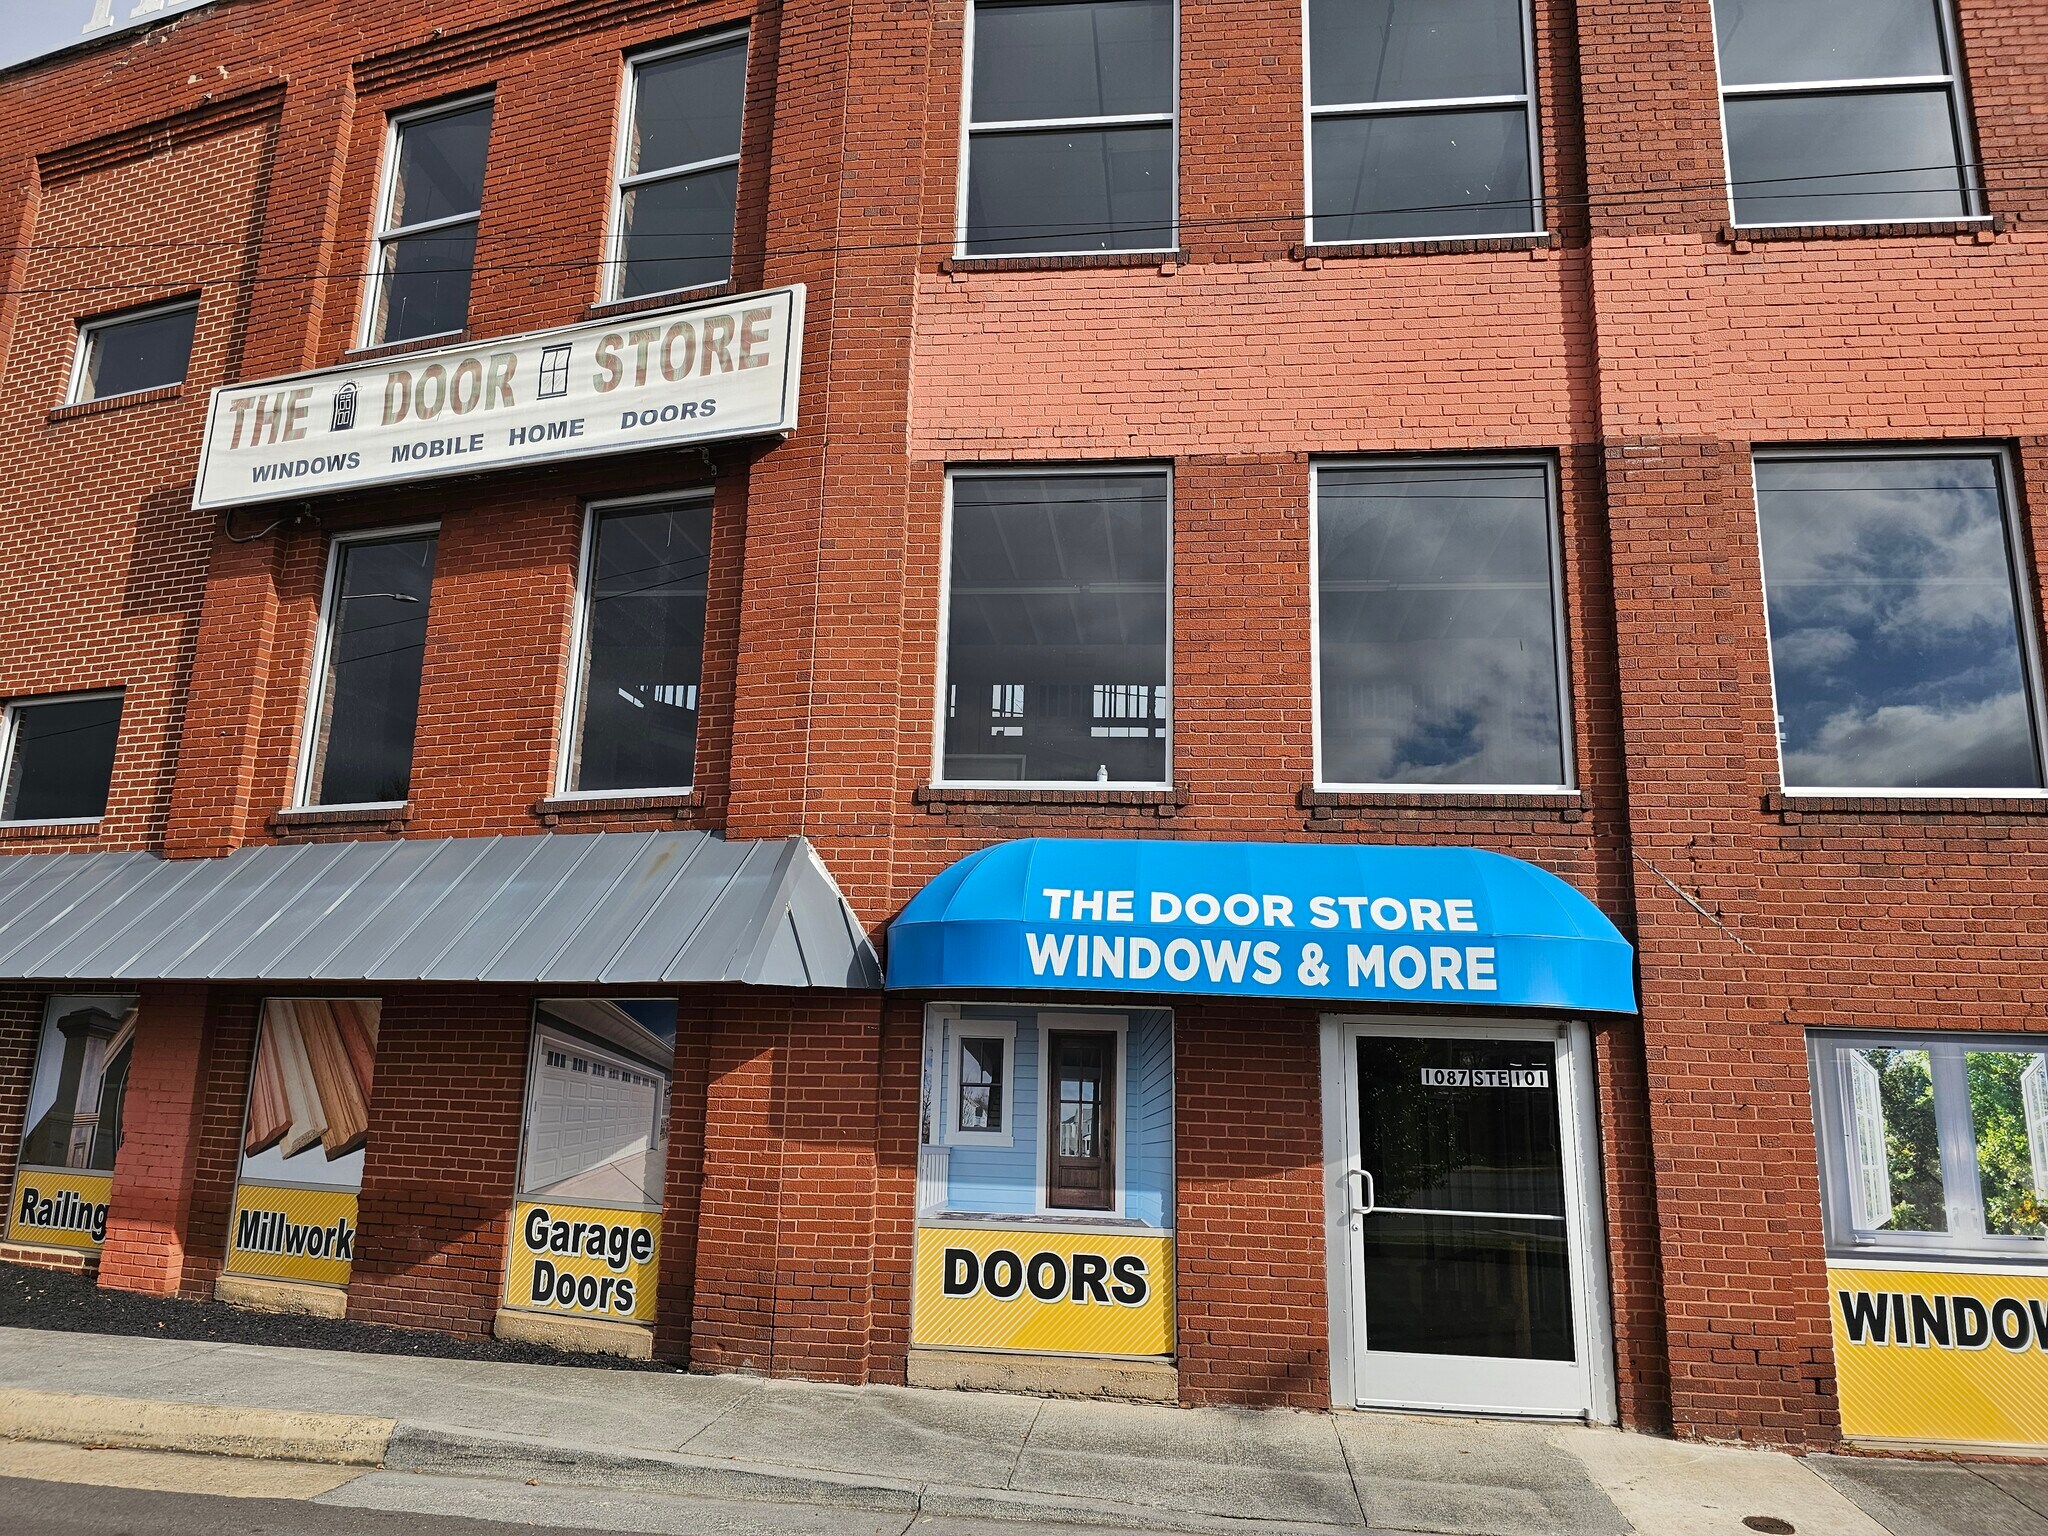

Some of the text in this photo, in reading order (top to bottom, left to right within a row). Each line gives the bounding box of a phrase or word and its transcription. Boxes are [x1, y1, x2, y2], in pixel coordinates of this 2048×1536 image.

[229, 306, 773, 450] THE DOOR STORE
[251, 398, 717, 483] WINDOWS MOBILE HOME DOORS
[1042, 888, 1479, 932] THE DOOR STORE
[1025, 932, 1498, 991] WINDOWS & MORE
[1425, 1069, 1544, 1086] 1087 STE 101
[236, 1209, 355, 1261] Millwork
[524, 1207, 654, 1273] Garage
[531, 1259, 637, 1316] Doors
[943, 1247, 1150, 1308] DOORS
